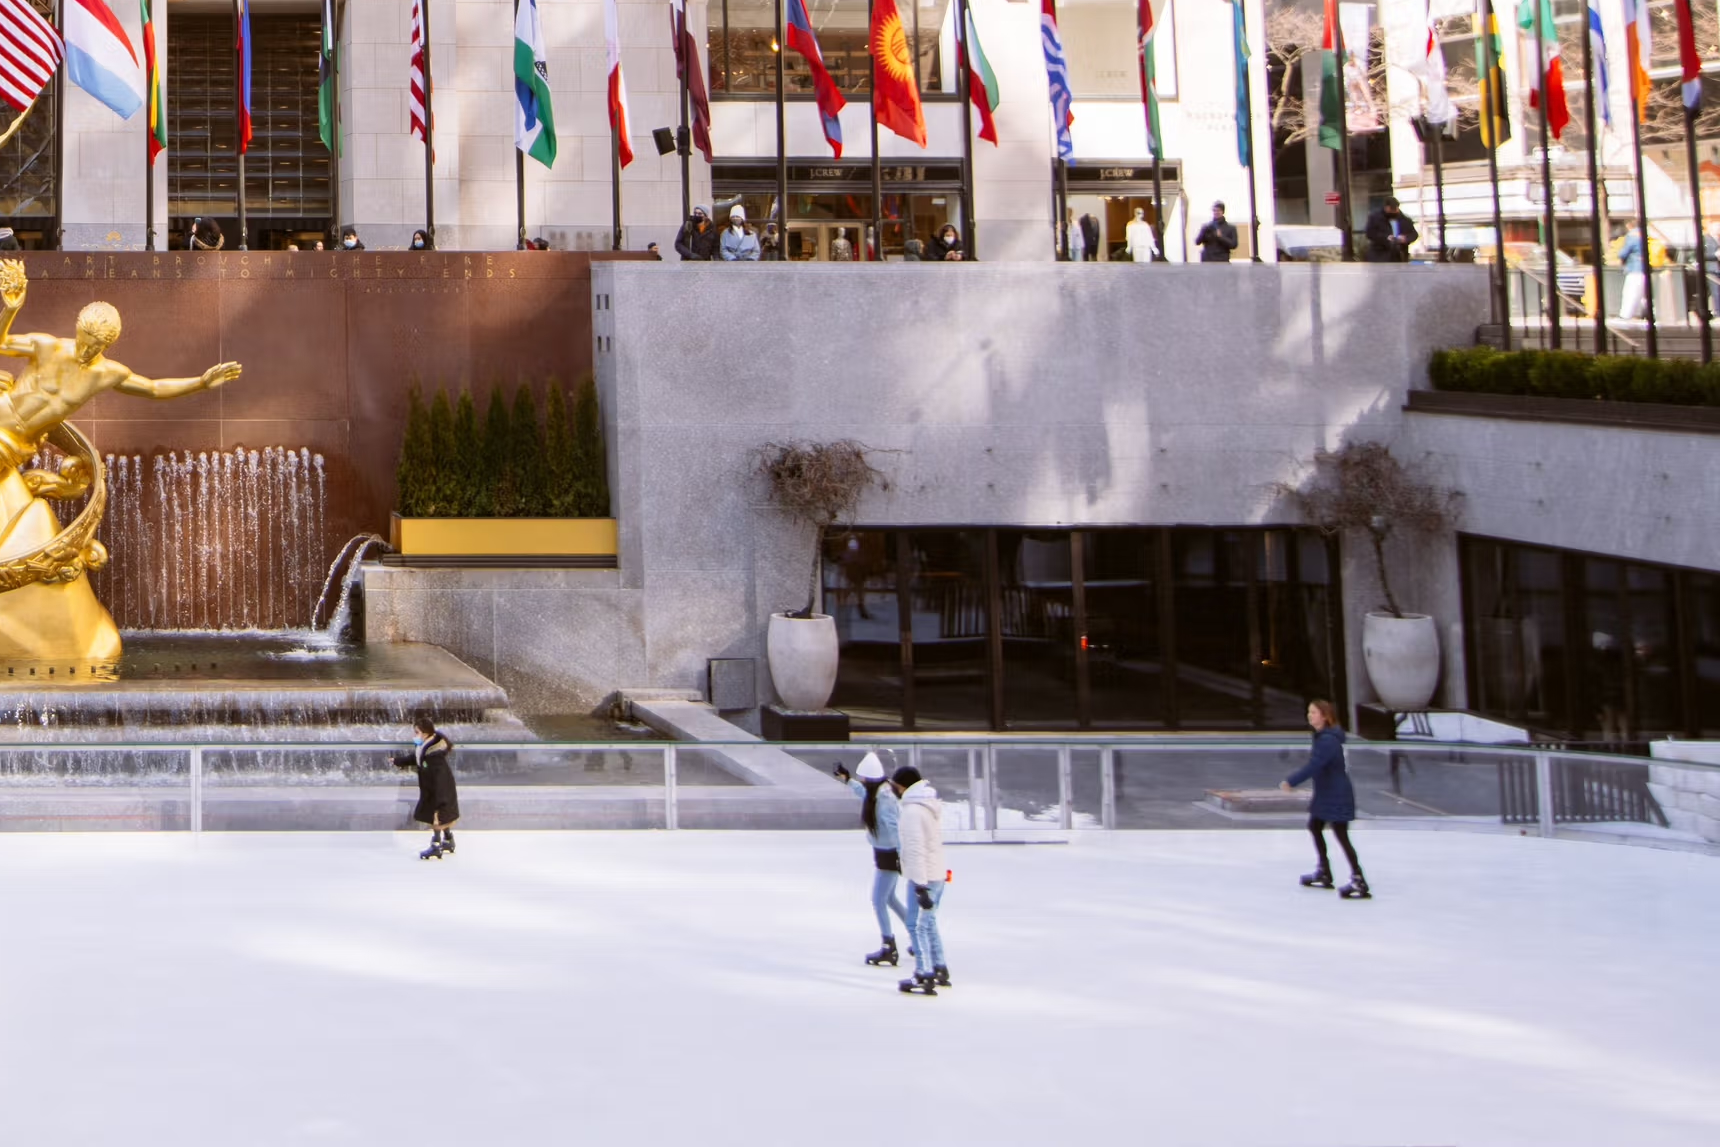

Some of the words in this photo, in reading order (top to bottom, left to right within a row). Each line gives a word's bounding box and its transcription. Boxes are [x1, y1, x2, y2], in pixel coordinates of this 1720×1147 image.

[809, 167, 843, 179] J.CREW
[63, 255, 115, 265] ART
[331, 255, 382, 265] THE
[420, 255, 493, 265] FIRE
[40, 268, 50, 278] A
[85, 268, 183, 278] MEANS
[221, 268, 251, 278] TO
[285, 268, 405, 278] MIGHTY
[443, 268, 517, 278] ENDS
